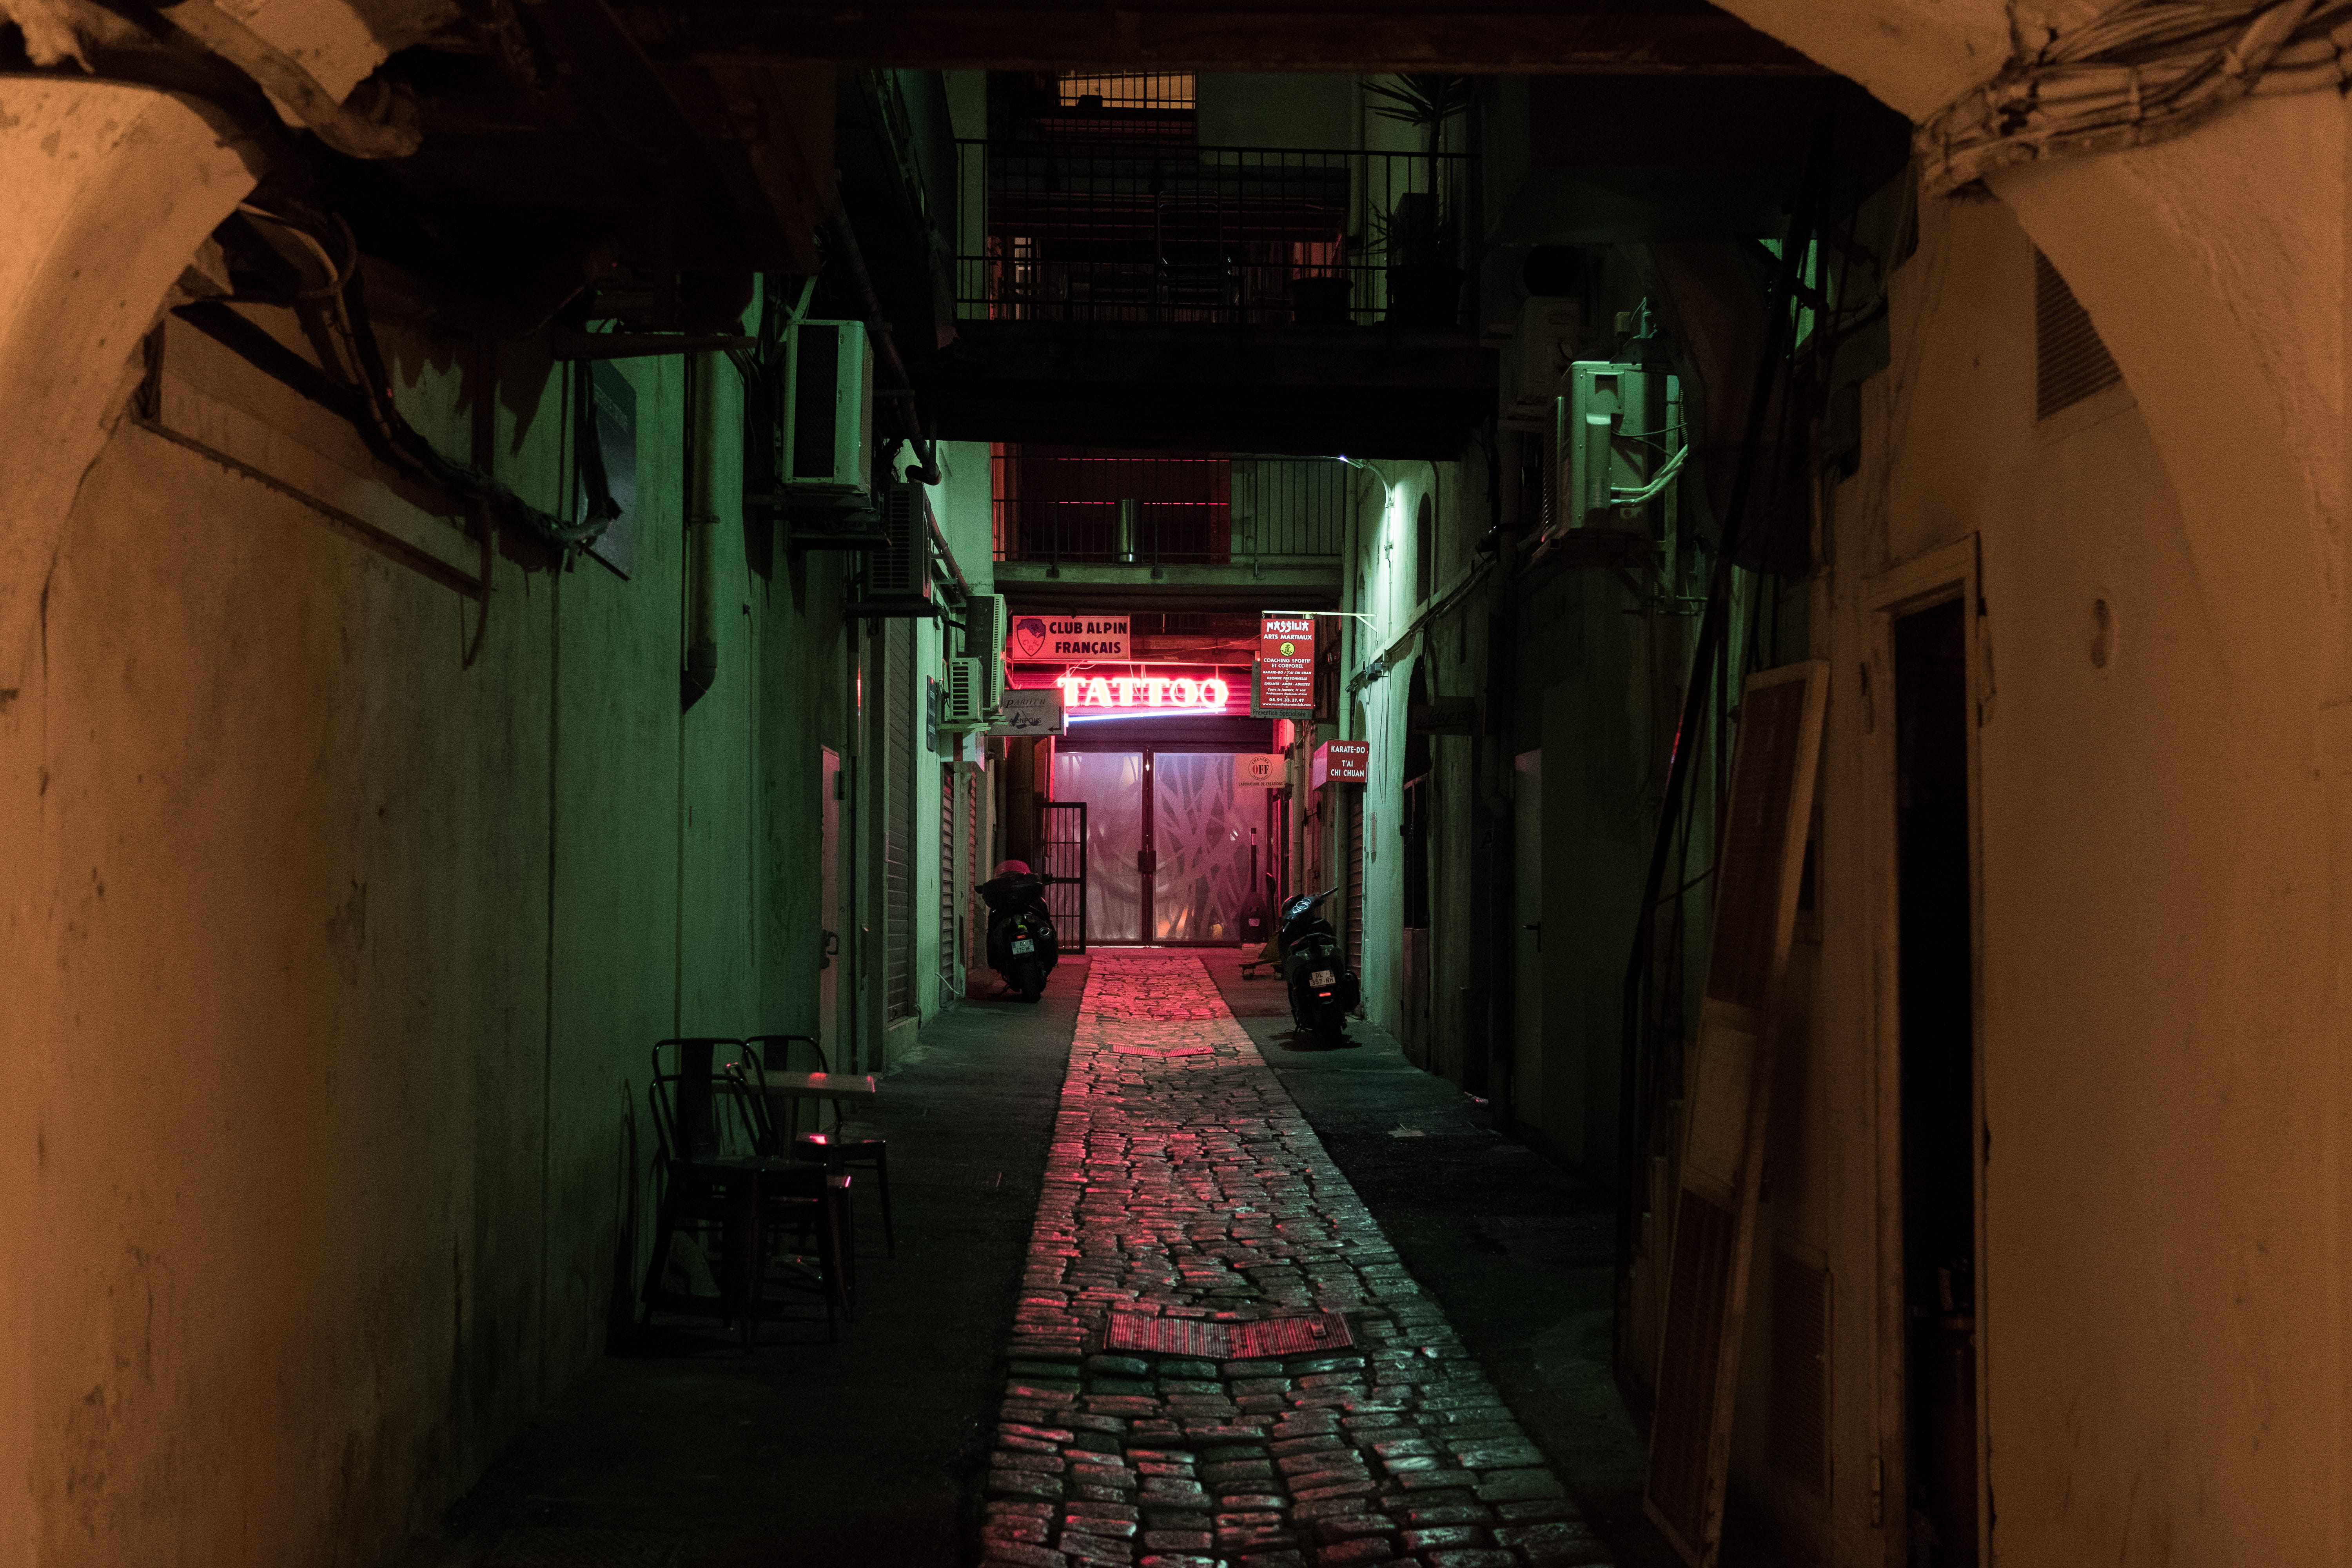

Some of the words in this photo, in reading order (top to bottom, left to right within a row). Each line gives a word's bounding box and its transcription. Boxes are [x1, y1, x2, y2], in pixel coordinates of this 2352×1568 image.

[1049, 622, 1082, 634] CLUB
[1087, 622, 1127, 634] ALPIN
[1267, 621, 1308, 633] MASSILIA
[1055, 642, 1121, 655] FRANÇAIS
[1058, 678, 1229, 708] TATTOO
[1457, 711, 1468, 721] 13
[1331, 745, 1365, 753] KARATE-DO
[1252, 765, 1269, 774] OFF
